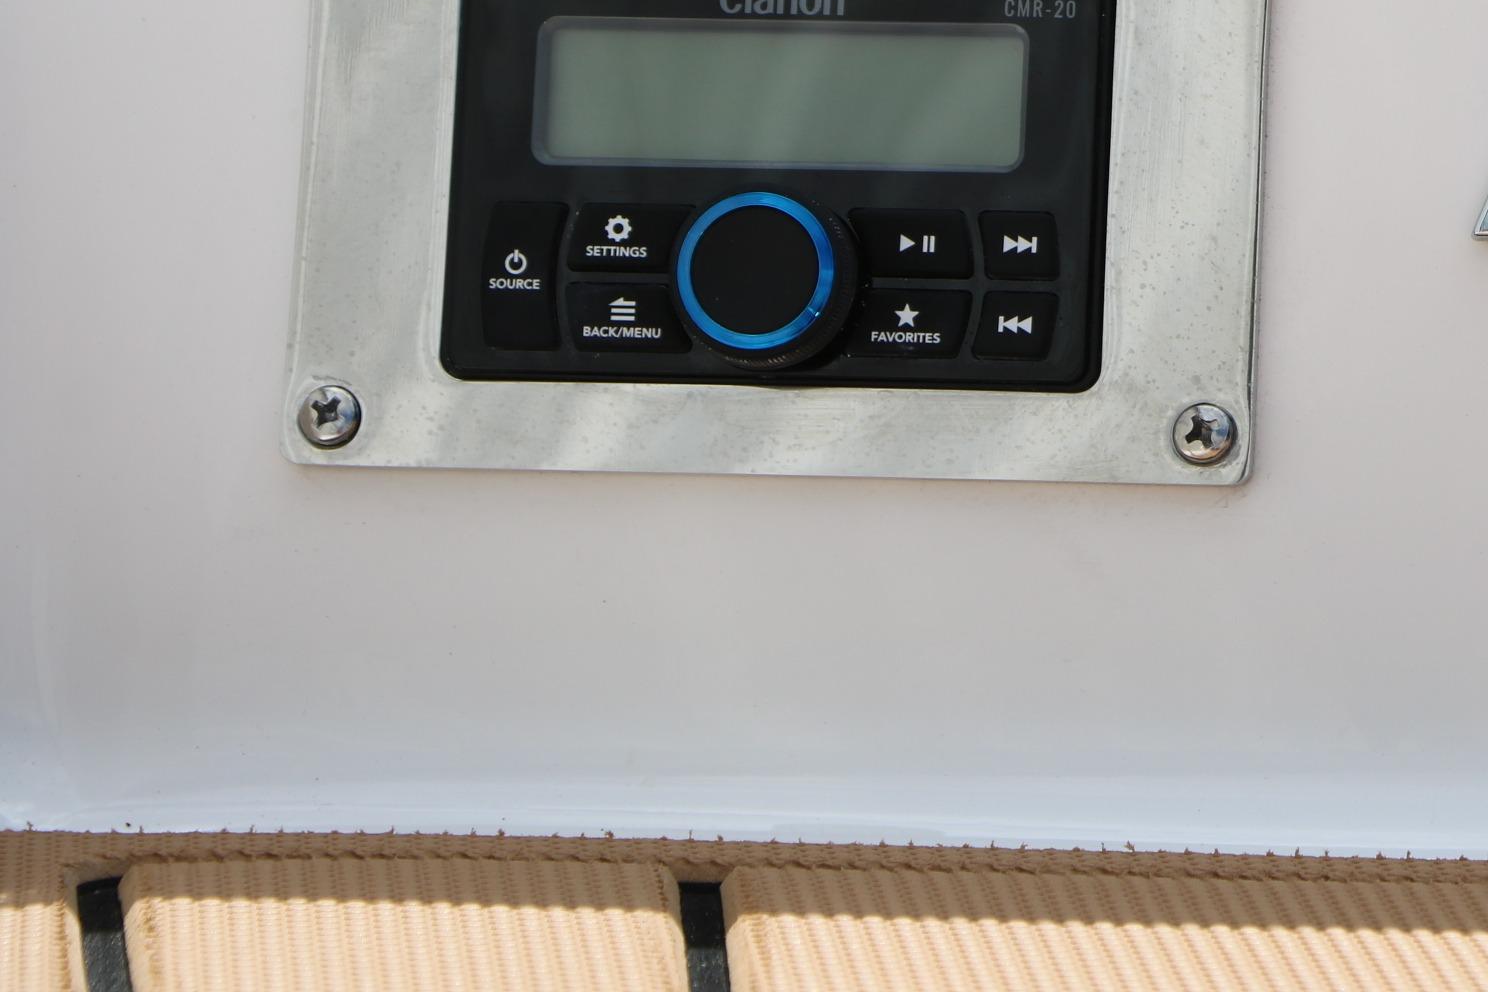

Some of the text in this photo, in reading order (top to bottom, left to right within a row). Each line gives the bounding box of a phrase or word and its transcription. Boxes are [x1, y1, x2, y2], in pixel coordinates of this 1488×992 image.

[1003, 0, 1077, 19] CMR-20
[585, 245, 647, 258] SETTINGS
[489, 277, 541, 290] SOURCE
[582, 325, 661, 339] BACK/MENU
[870, 331, 941, 344] FAVORITES
